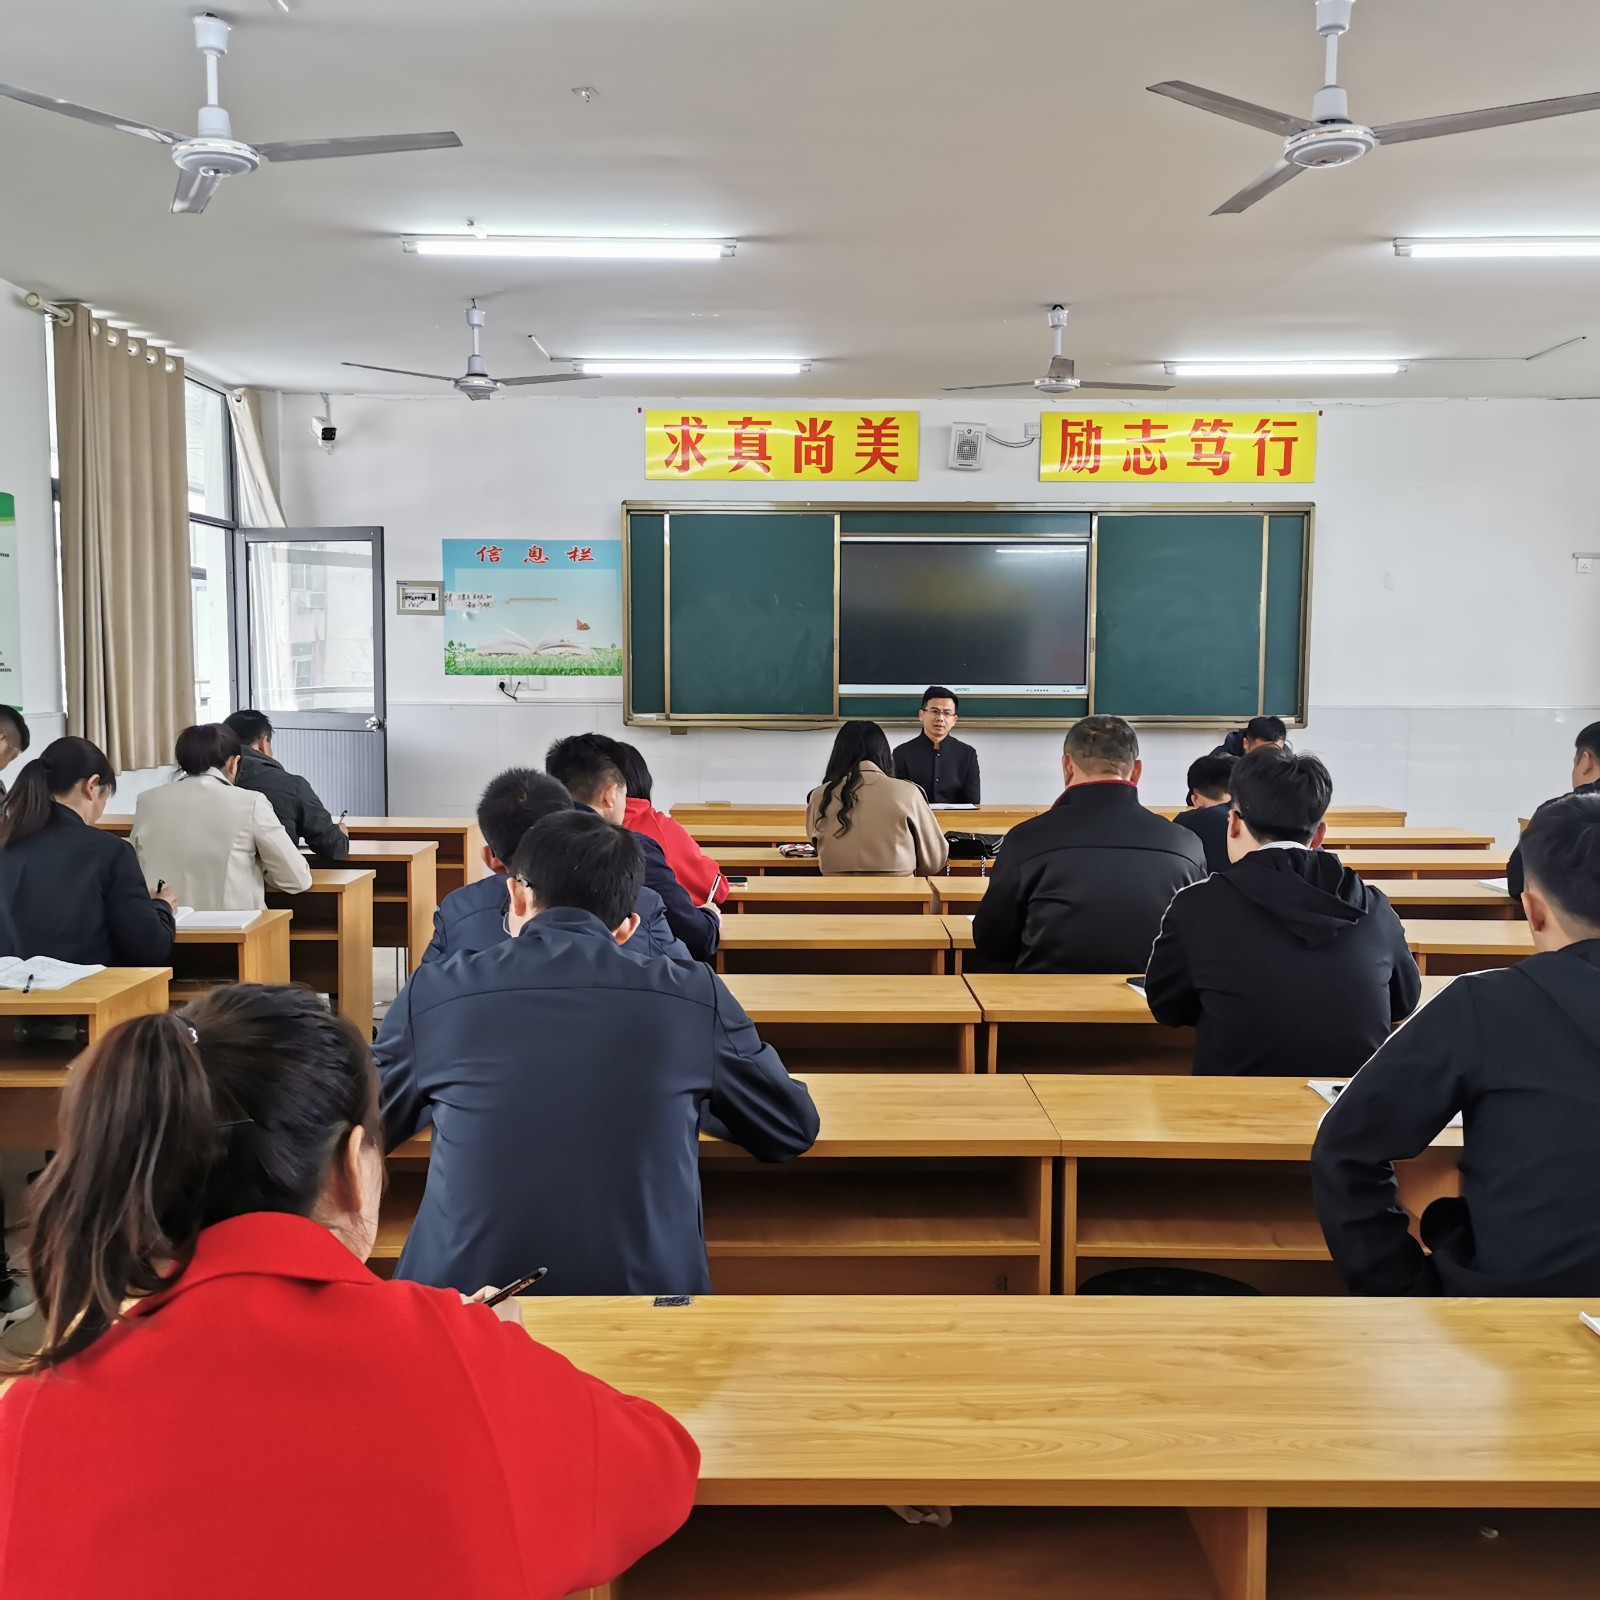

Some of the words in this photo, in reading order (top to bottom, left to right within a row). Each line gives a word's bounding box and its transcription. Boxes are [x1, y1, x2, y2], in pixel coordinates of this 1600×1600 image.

[664, 416, 901, 475] 求真尚美
[1059, 418, 1299, 478] 励志笃行
[476, 545, 595, 564] 信息栏
